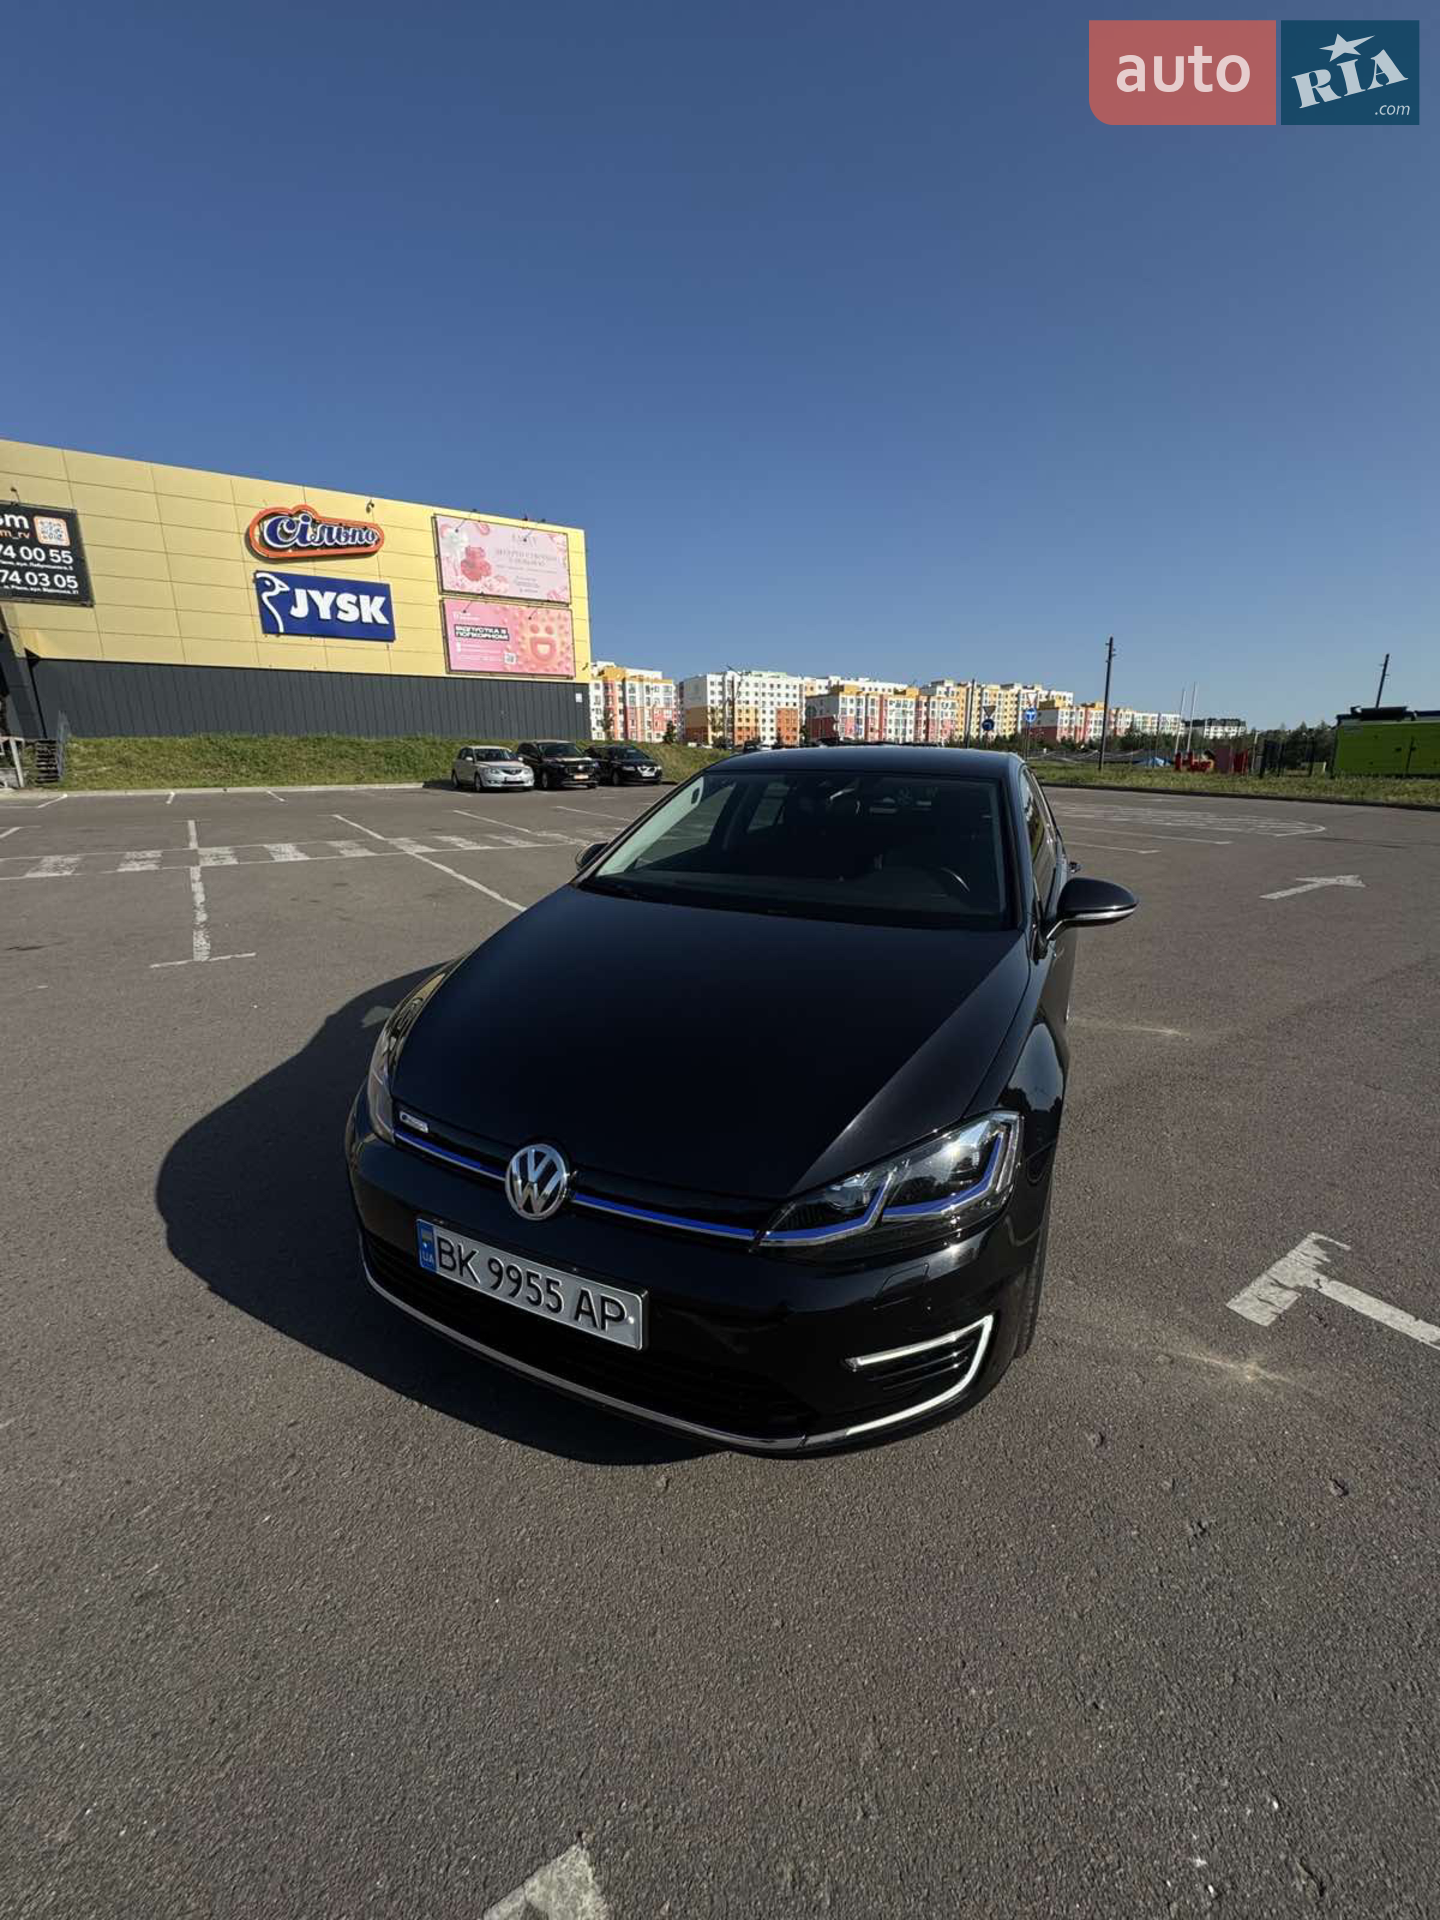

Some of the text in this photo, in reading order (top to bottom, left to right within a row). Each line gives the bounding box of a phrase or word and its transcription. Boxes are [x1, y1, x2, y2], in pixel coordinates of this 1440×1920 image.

[263, 513, 379, 549] Сільпо
[19, 546, 46, 562] 00
[49, 549, 74, 564] 55
[25, 572, 51, 587] 03
[53, 574, 79, 589] 05
[289, 588, 390, 625] JYSK
[421, 1251, 434, 1264] UA
[437, 1236, 628, 1331] BK 9955 AP
